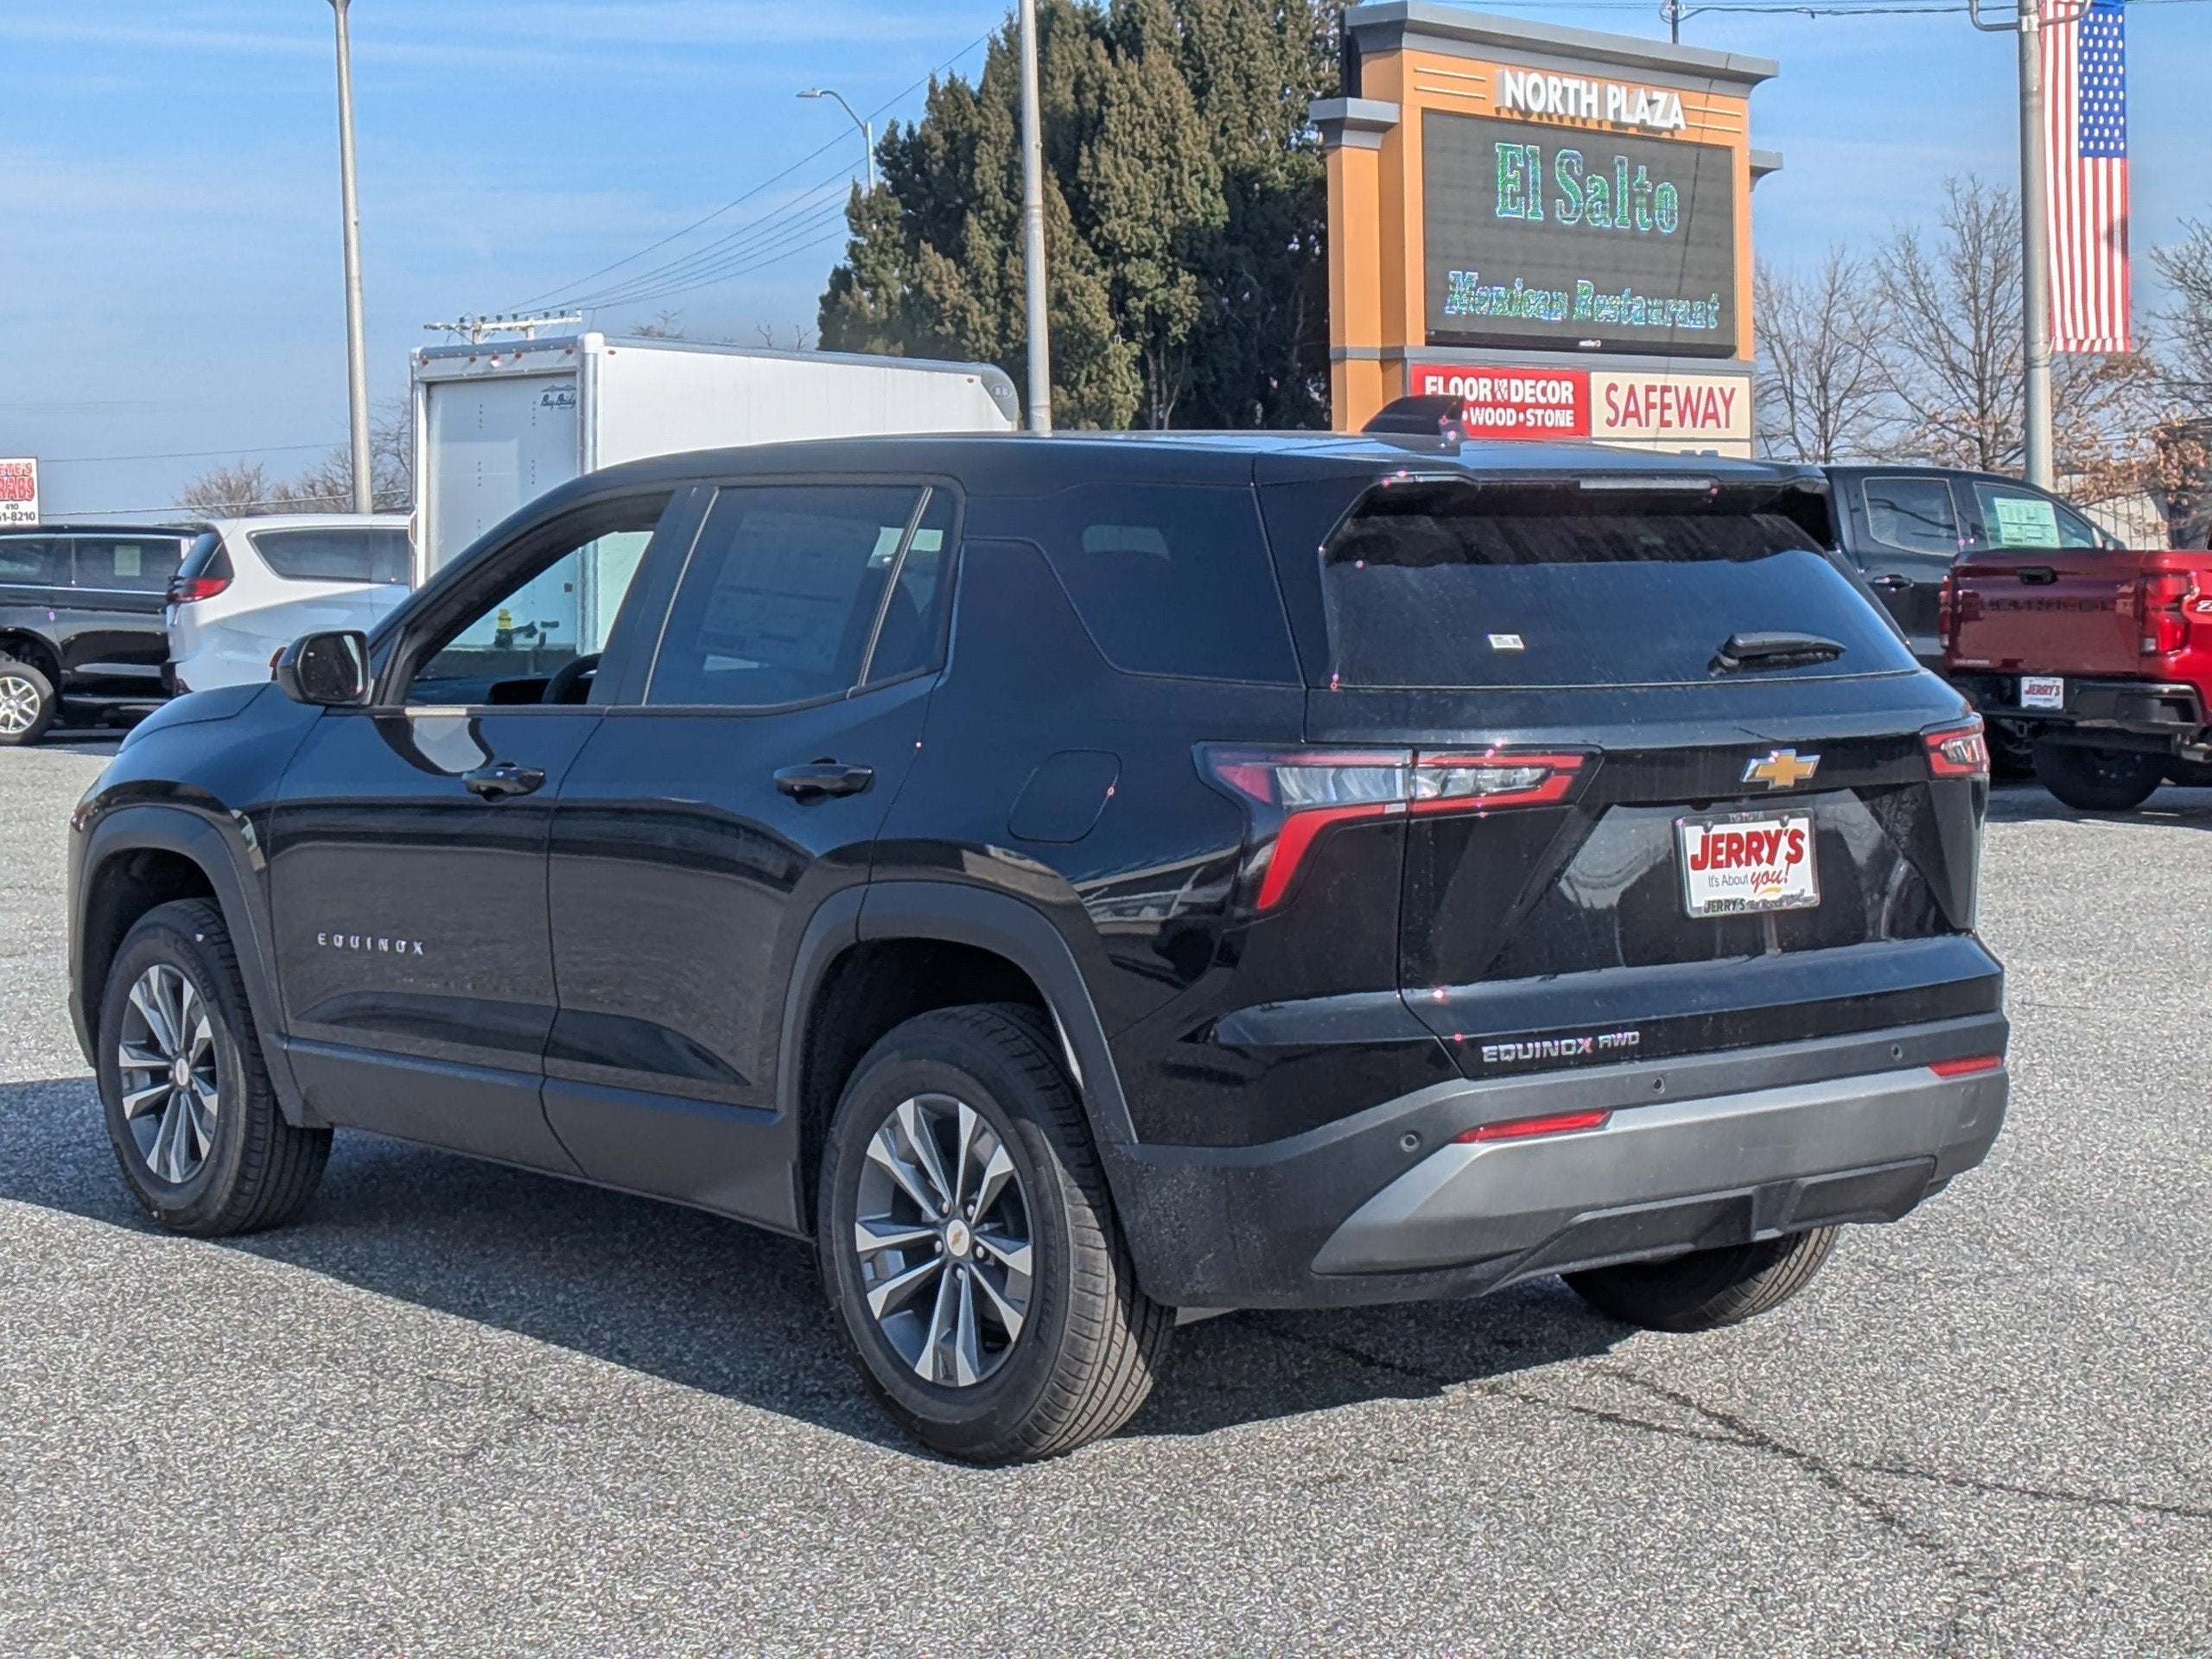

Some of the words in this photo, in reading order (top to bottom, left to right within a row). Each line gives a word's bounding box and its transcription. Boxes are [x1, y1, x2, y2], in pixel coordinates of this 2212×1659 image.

[1503, 68, 1599, 119] NORTH
[1607, 84, 1687, 130] PLAZA
[1495, 142, 1544, 221] El
[1554, 149, 1680, 234] Salto
[1469, 406, 1517, 427] WOOD
[1525, 408, 1575, 428] STONE
[1605, 382, 1737, 429] SAFEWAY
[1690, 828, 1806, 871] JERRY'S
[1708, 874, 1720, 887] It's
[1721, 874, 1749, 887] About
[1750, 862, 1789, 893] you!
[316, 932, 423, 956] EQUINOX
[1481, 1037, 1593, 1063] EQUINOX
[1598, 1031, 1640, 1049] AWD
